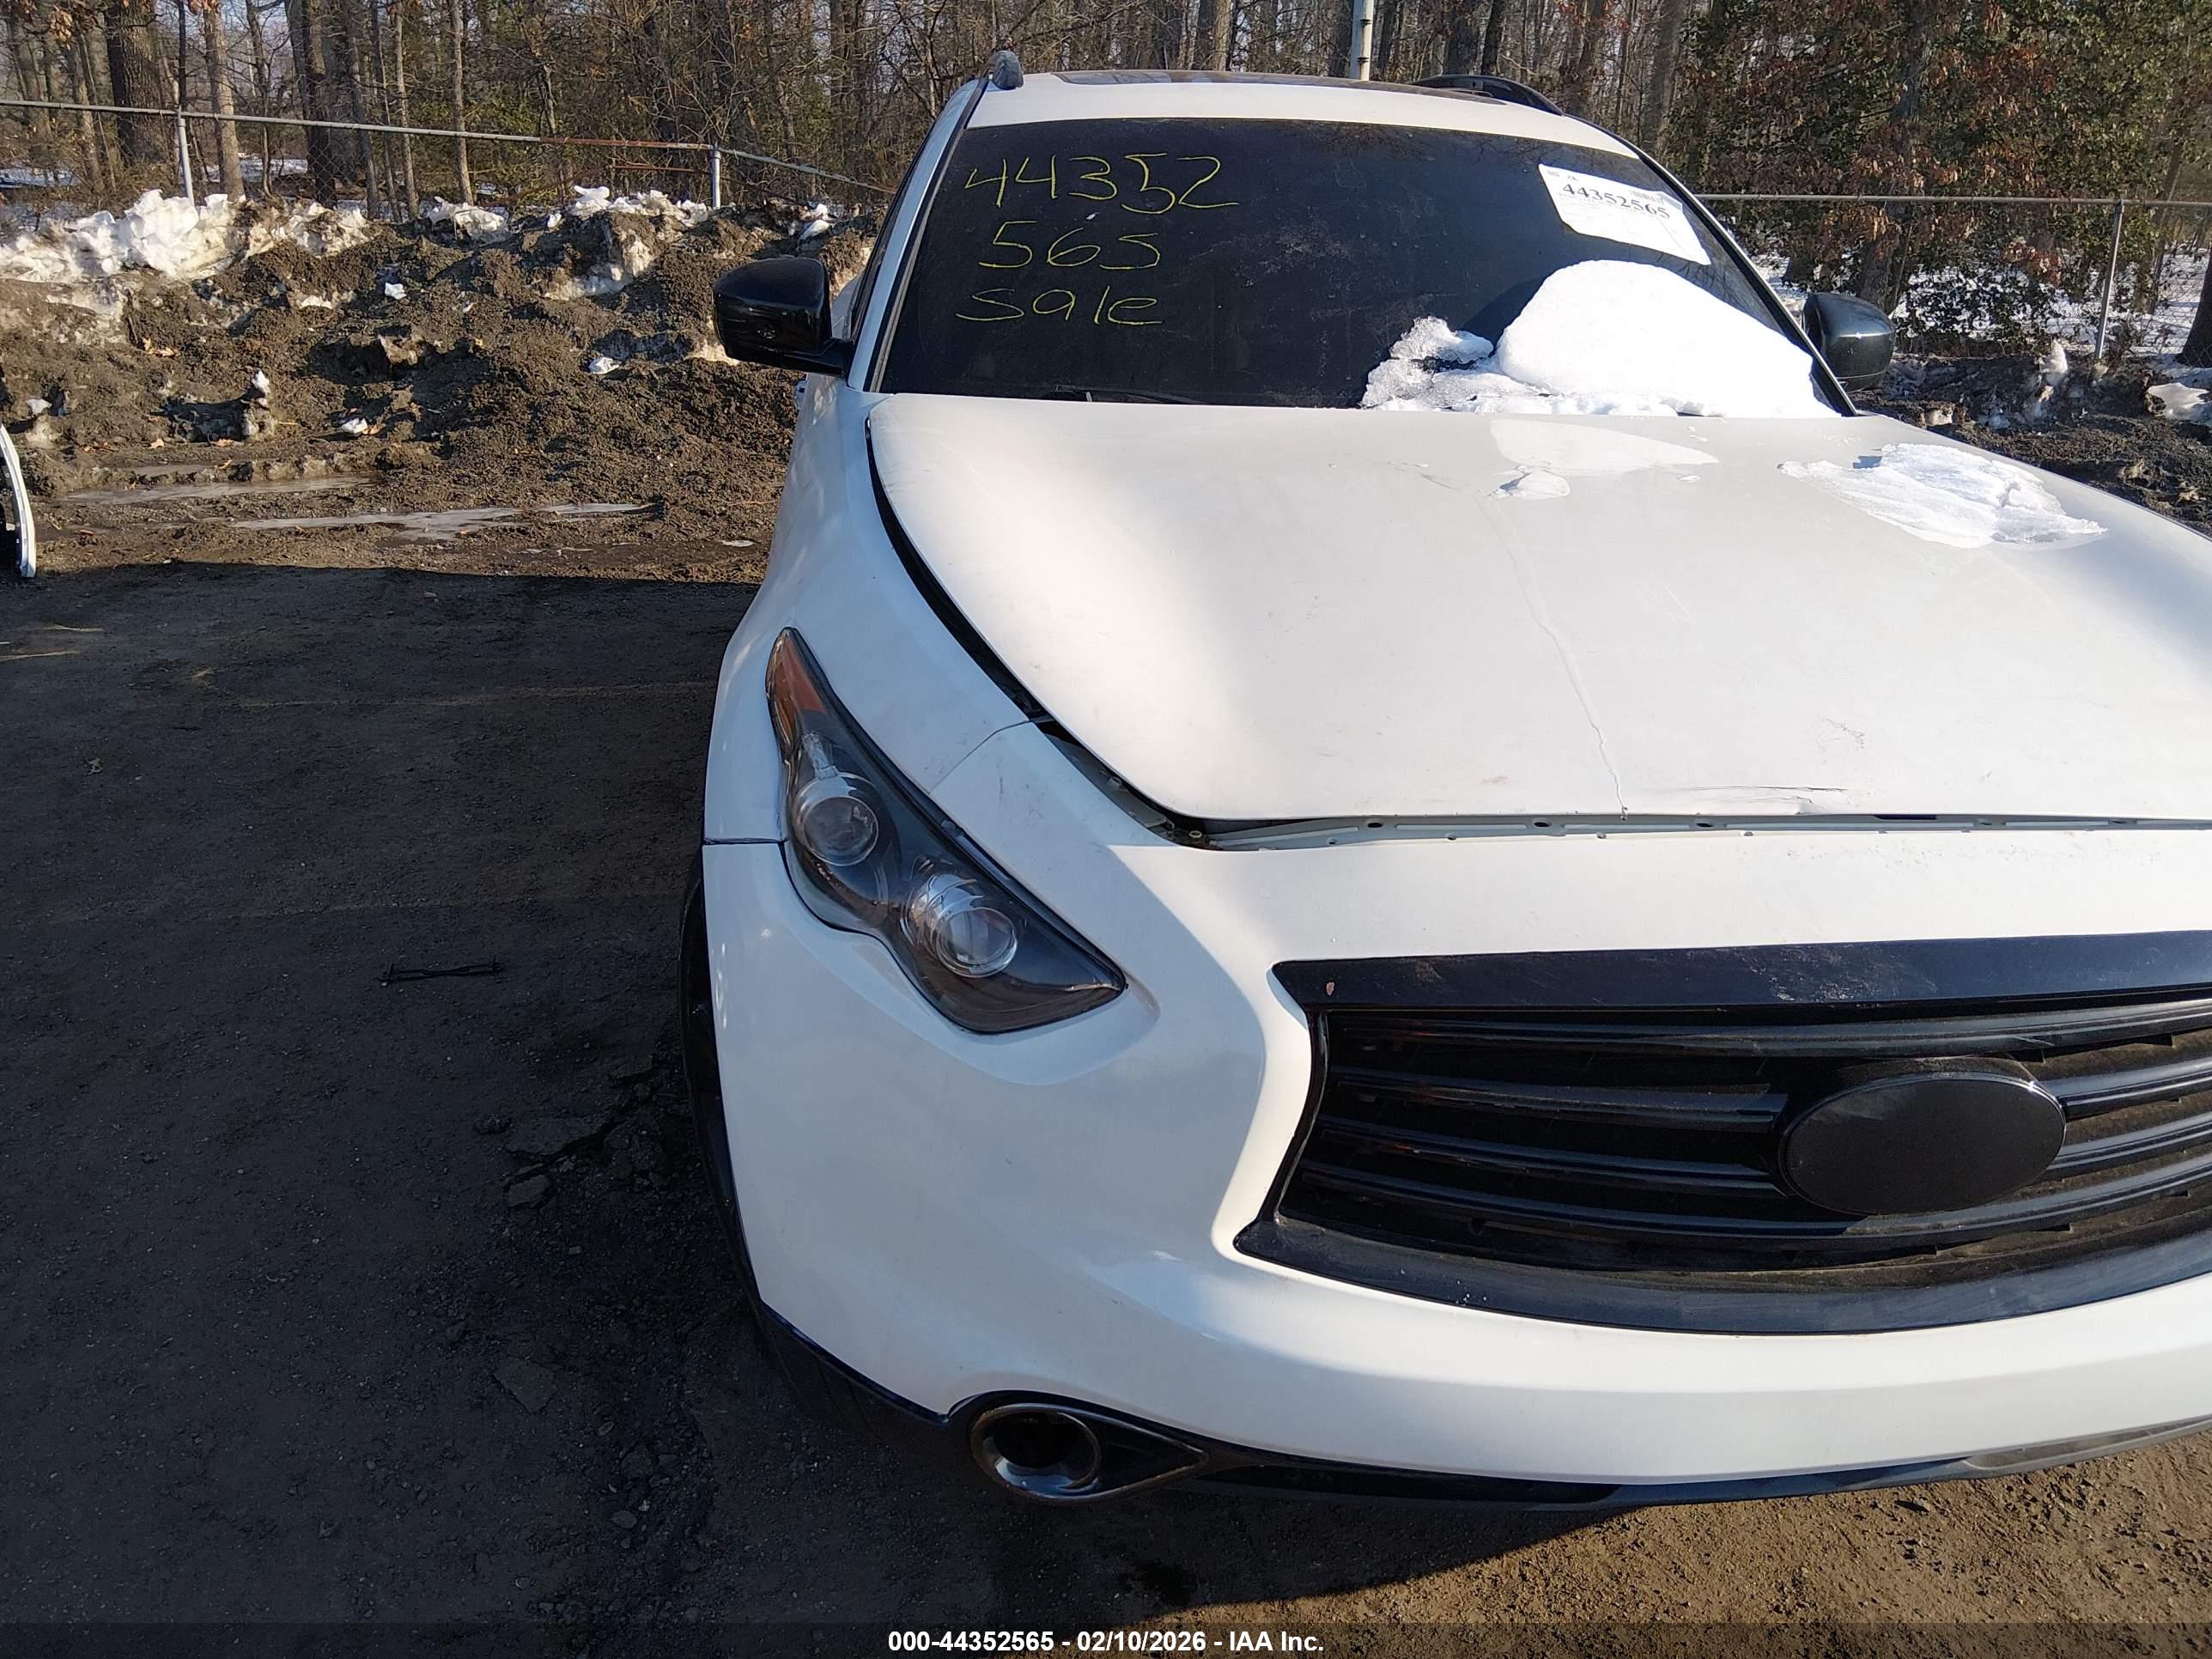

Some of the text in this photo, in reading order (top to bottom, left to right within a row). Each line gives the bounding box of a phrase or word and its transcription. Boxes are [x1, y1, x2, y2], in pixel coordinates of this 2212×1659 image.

[963, 153, 1239, 214] 44352
[1563, 183, 1670, 220] 44352565
[979, 221, 1161, 270] 565
